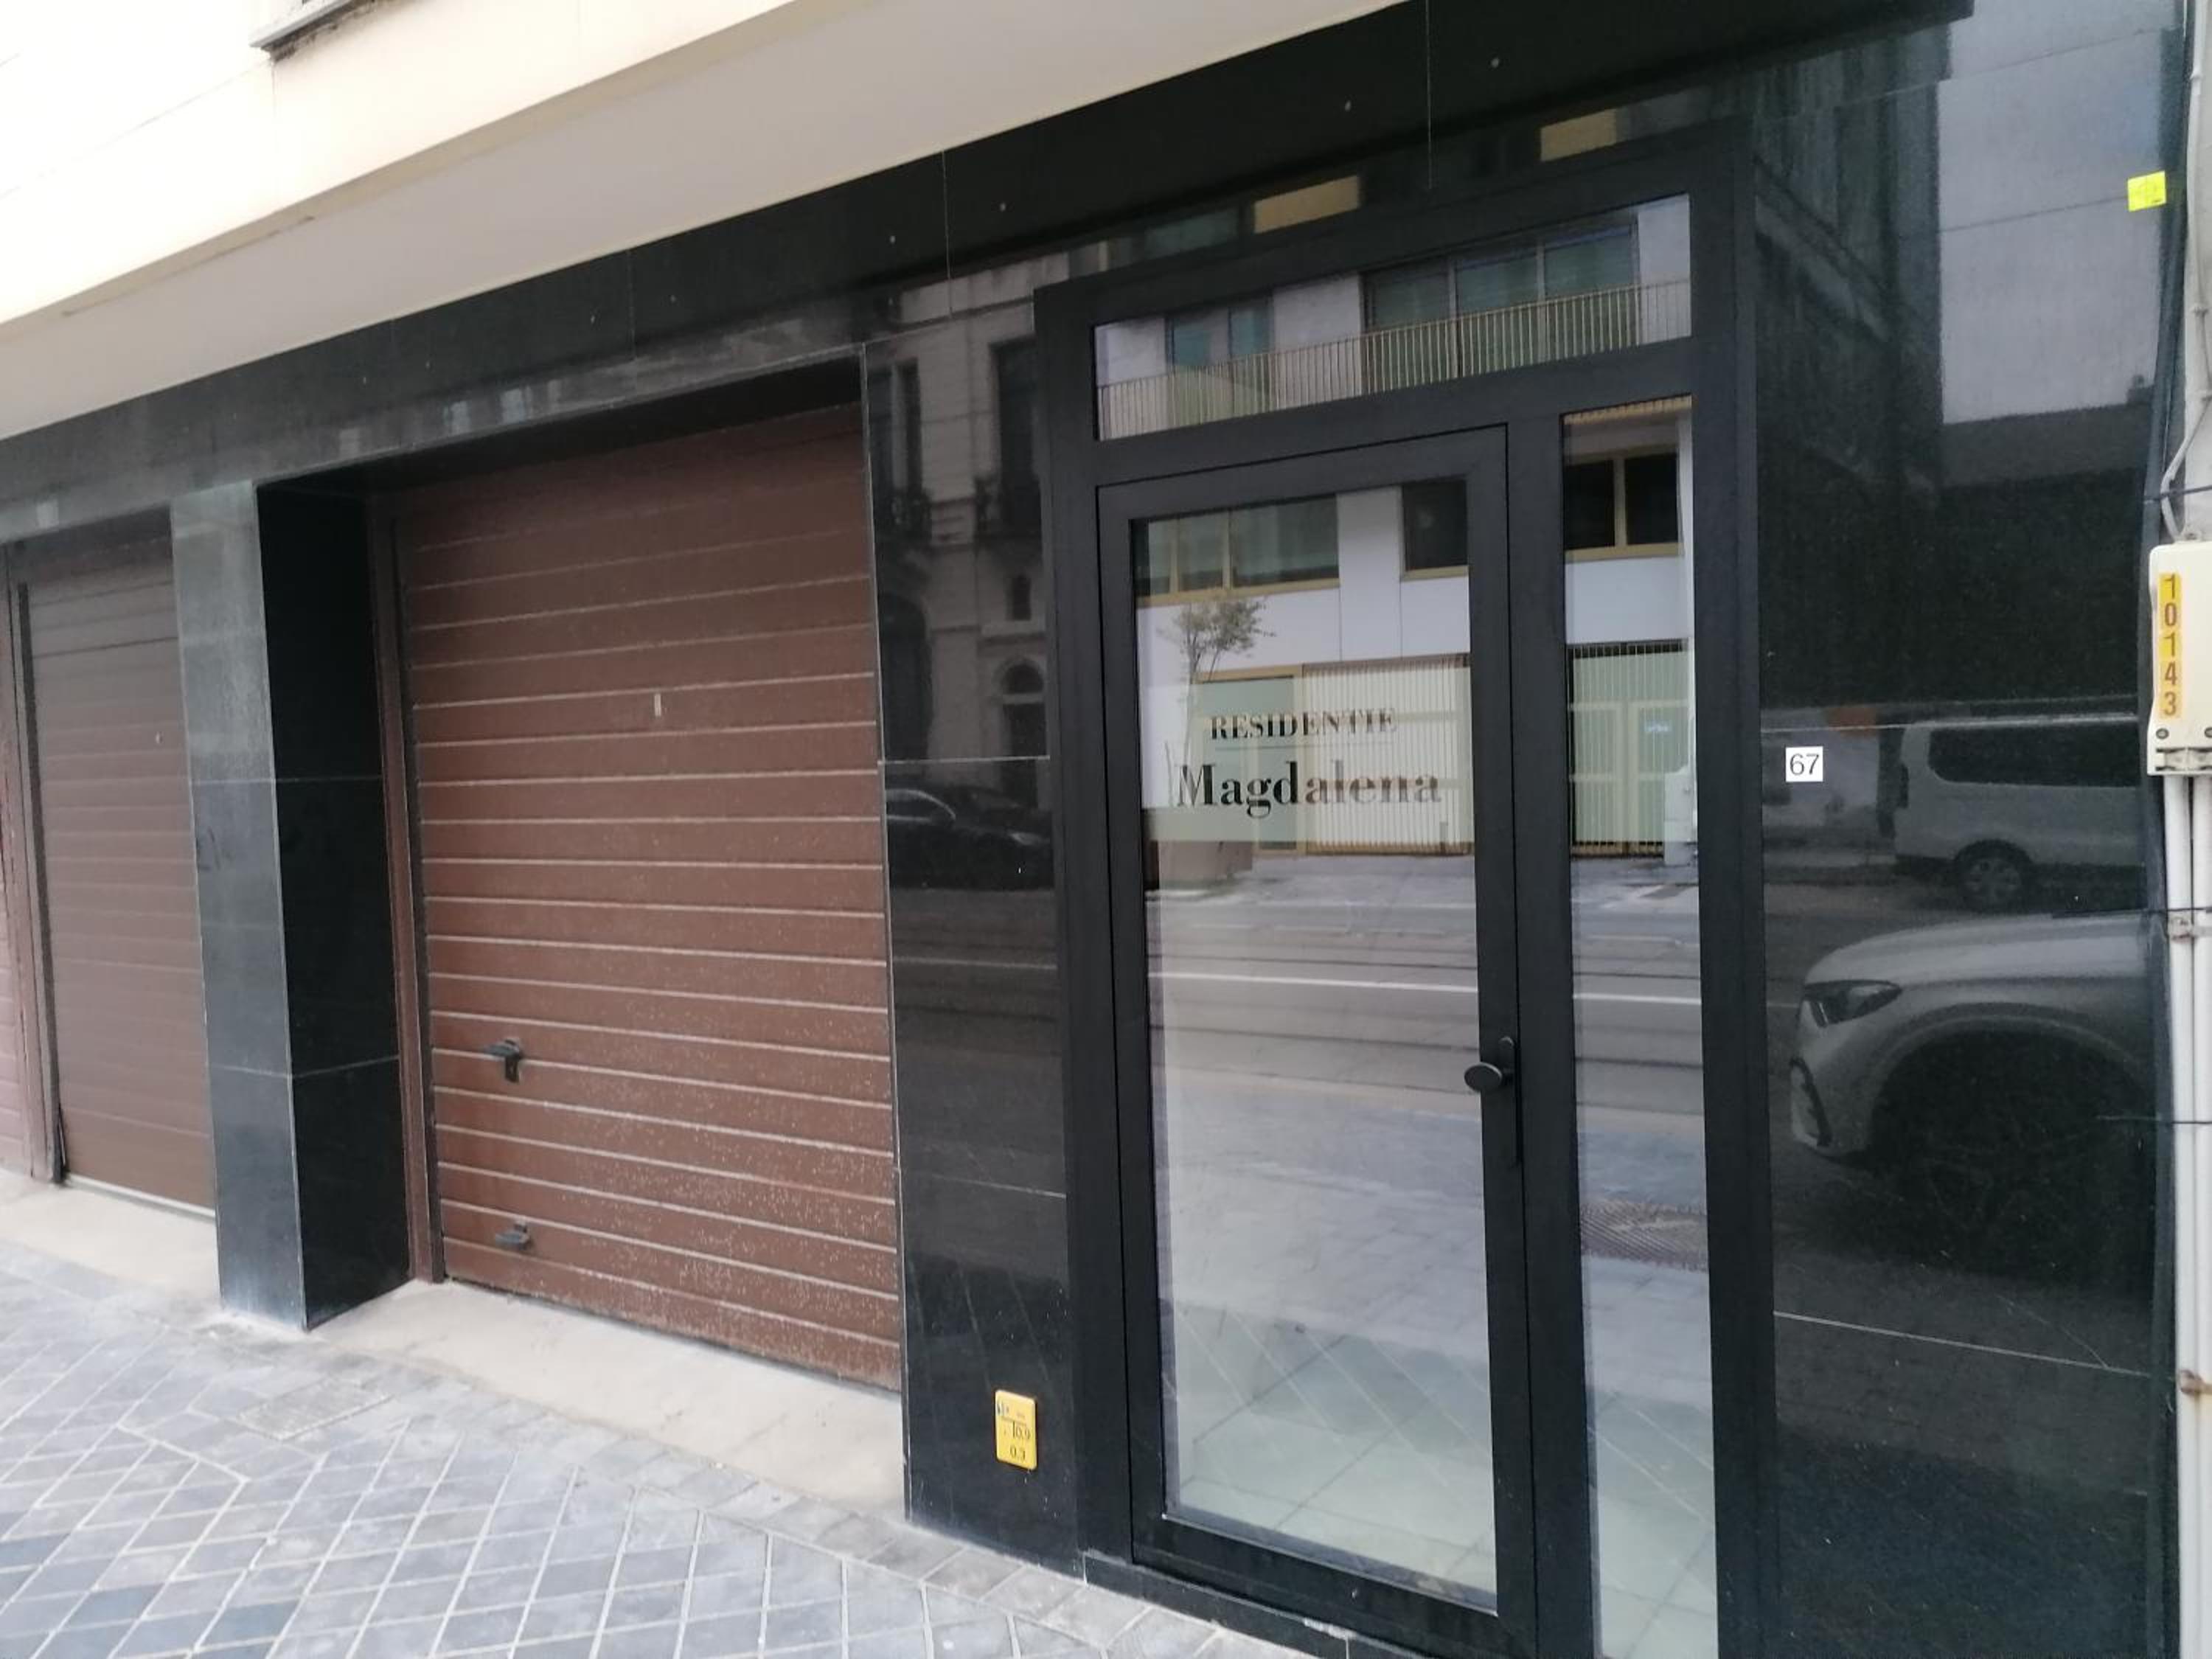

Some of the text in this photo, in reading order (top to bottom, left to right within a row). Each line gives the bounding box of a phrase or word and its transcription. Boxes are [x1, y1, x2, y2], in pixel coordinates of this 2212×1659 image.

[2163, 573, 2178, 716] 10143
[1211, 707, 1397, 740] RESIDENTIE
[1790, 753, 1819, 776] 67
[1177, 759, 1441, 819] Magdalena
